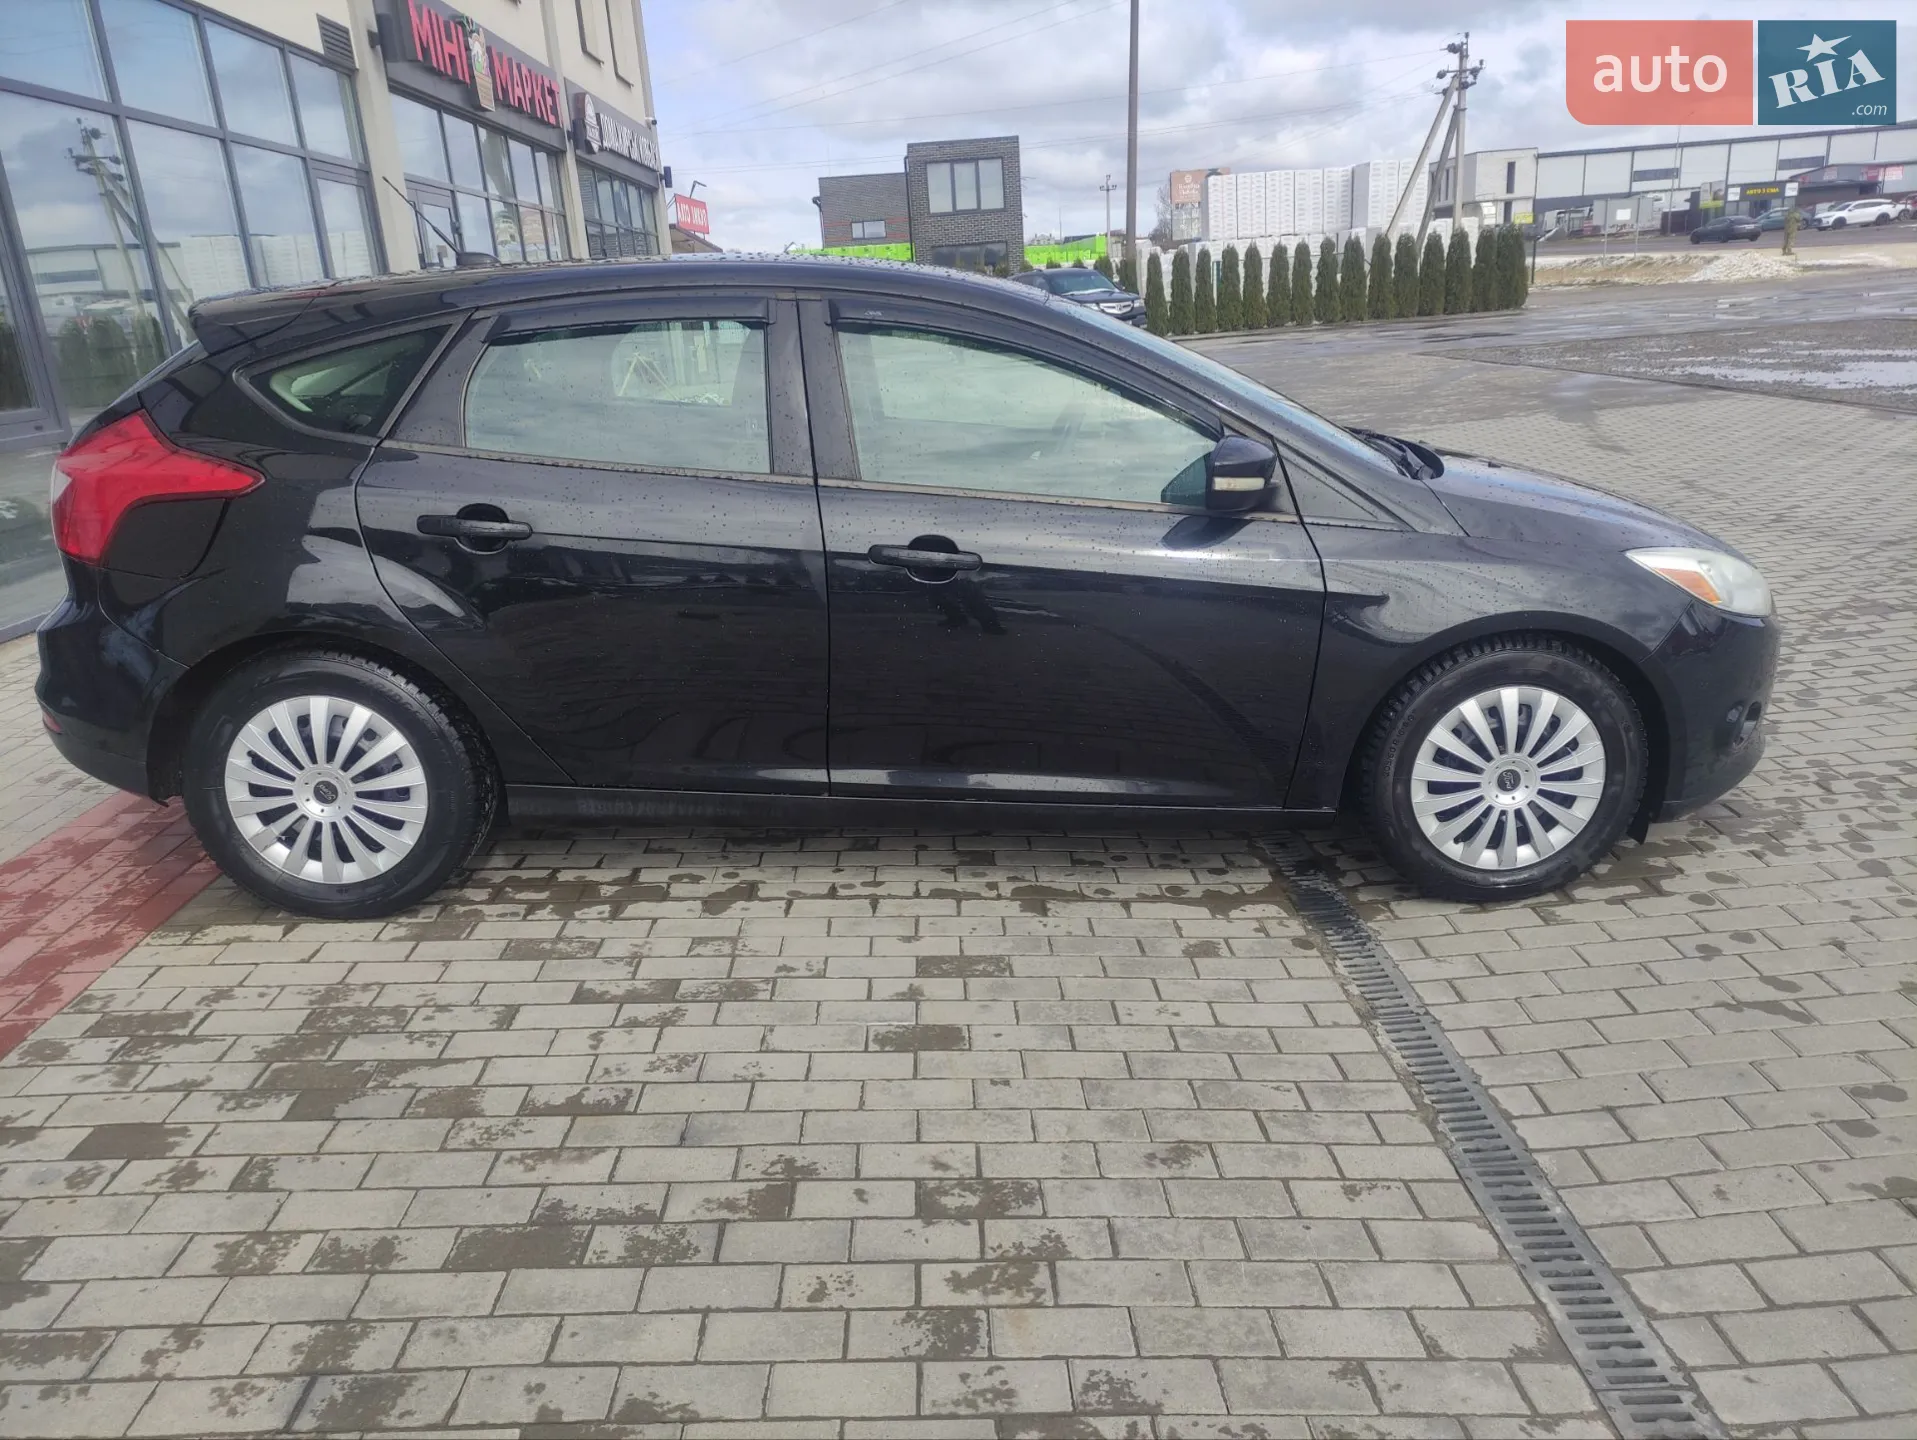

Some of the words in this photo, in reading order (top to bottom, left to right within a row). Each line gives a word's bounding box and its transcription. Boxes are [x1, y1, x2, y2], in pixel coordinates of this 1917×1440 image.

[408, 0, 470, 87] МІНІ
[491, 45, 563, 128] МАРКЕТ
[676, 202, 691, 224] АВТО
